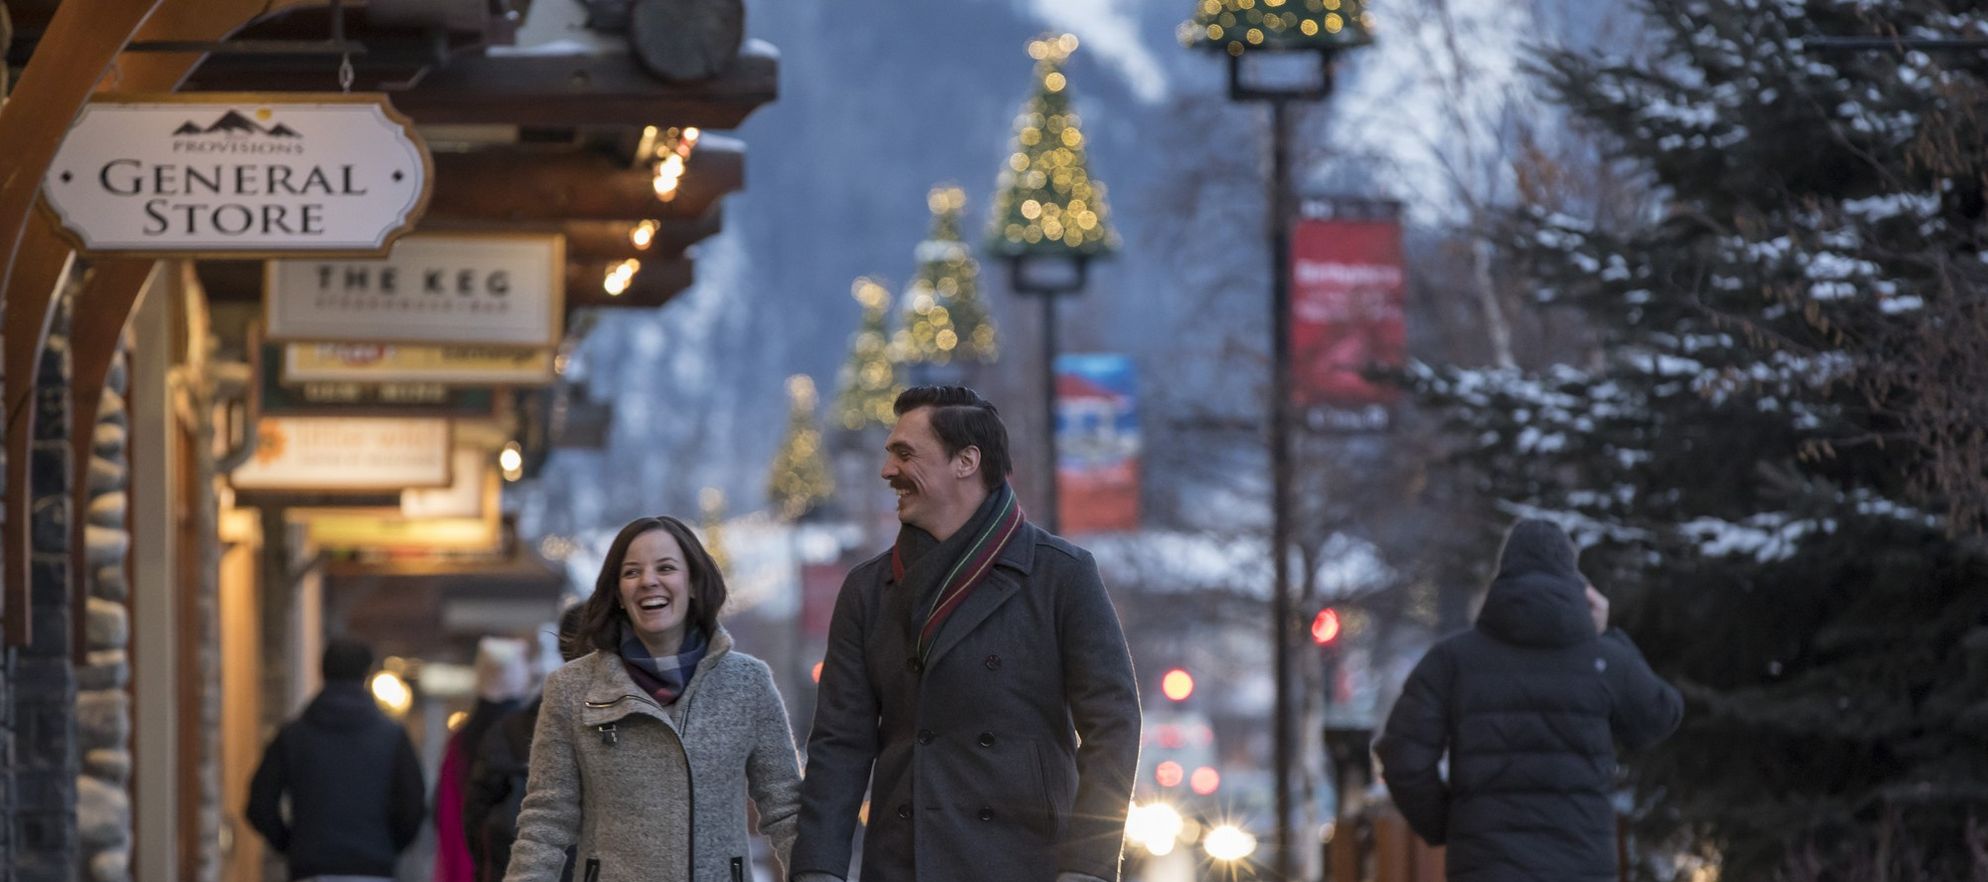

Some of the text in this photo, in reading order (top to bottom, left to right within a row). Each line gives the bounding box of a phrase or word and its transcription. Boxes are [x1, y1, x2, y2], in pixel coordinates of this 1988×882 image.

[172, 140, 305, 155] PROVISIONS
[100, 158, 368, 197] GENERAL
[142, 199, 326, 237] STORE
[317, 264, 511, 298] THE KEG
